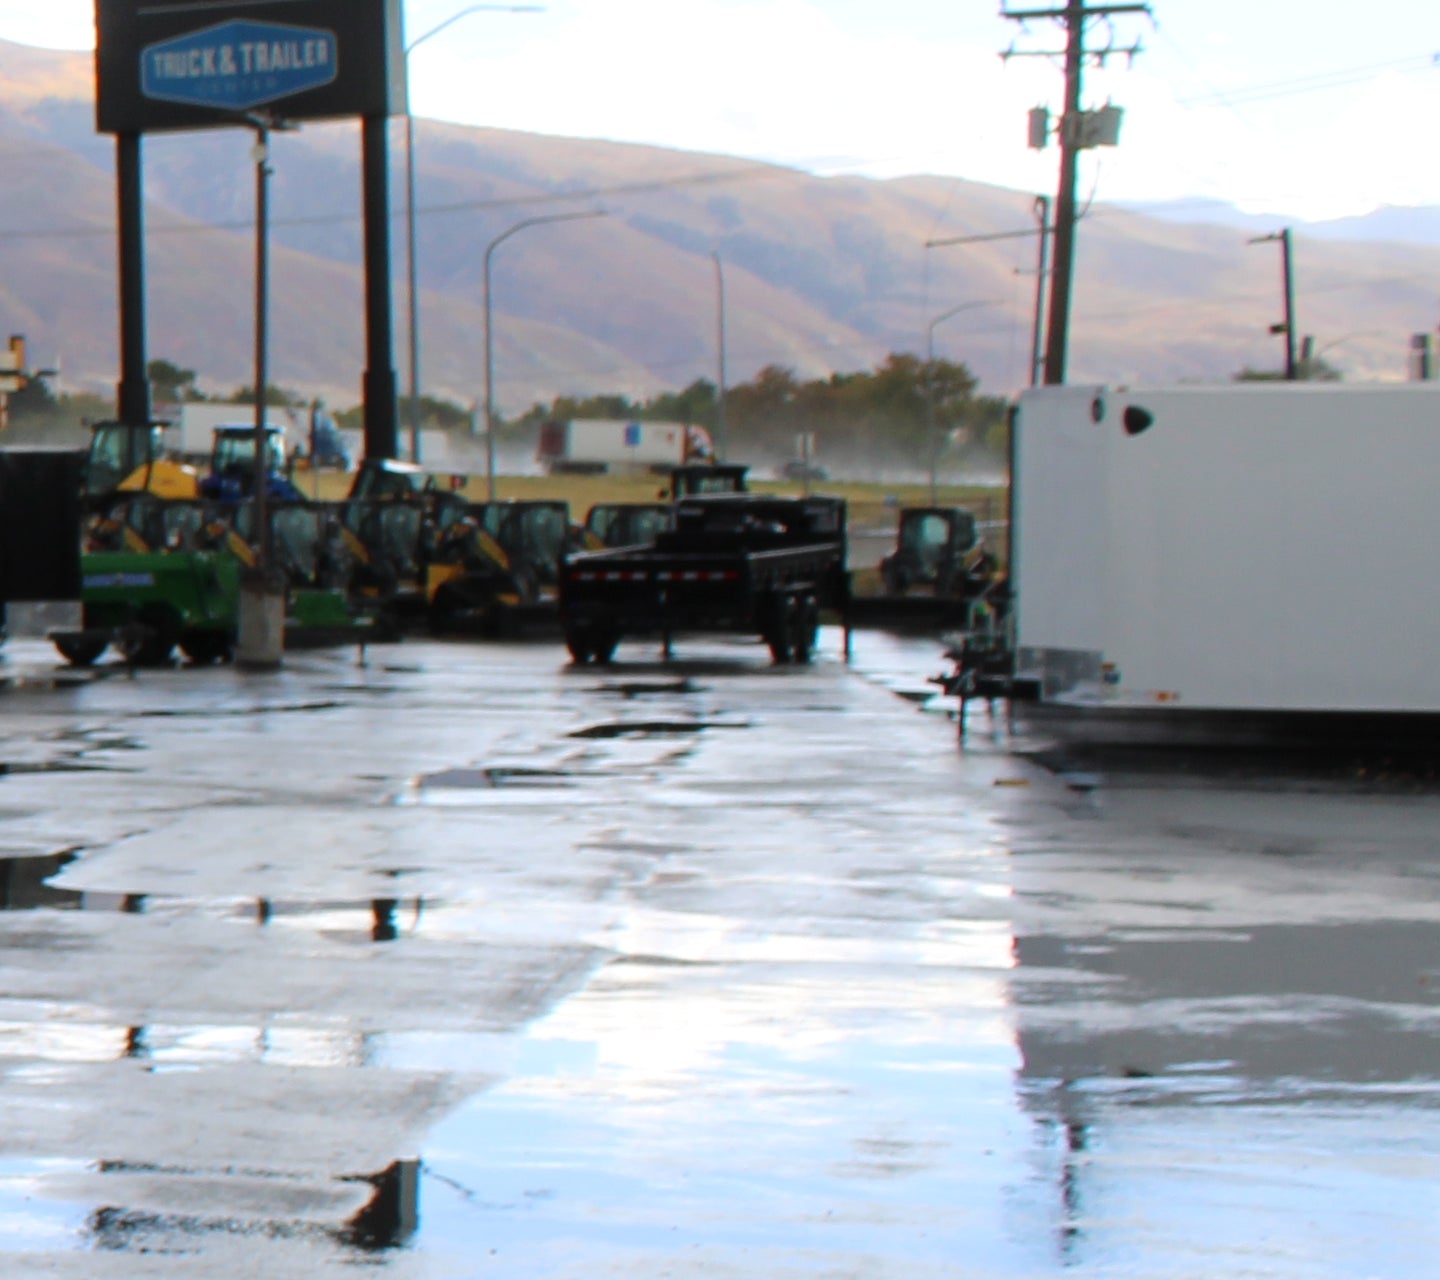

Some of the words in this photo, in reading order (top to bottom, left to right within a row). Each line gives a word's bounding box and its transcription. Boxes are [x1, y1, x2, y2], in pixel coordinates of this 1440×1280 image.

[153, 48, 216, 79] TRUCK
[219, 44, 237, 75] &
[240, 39, 329, 72] TRAILER
